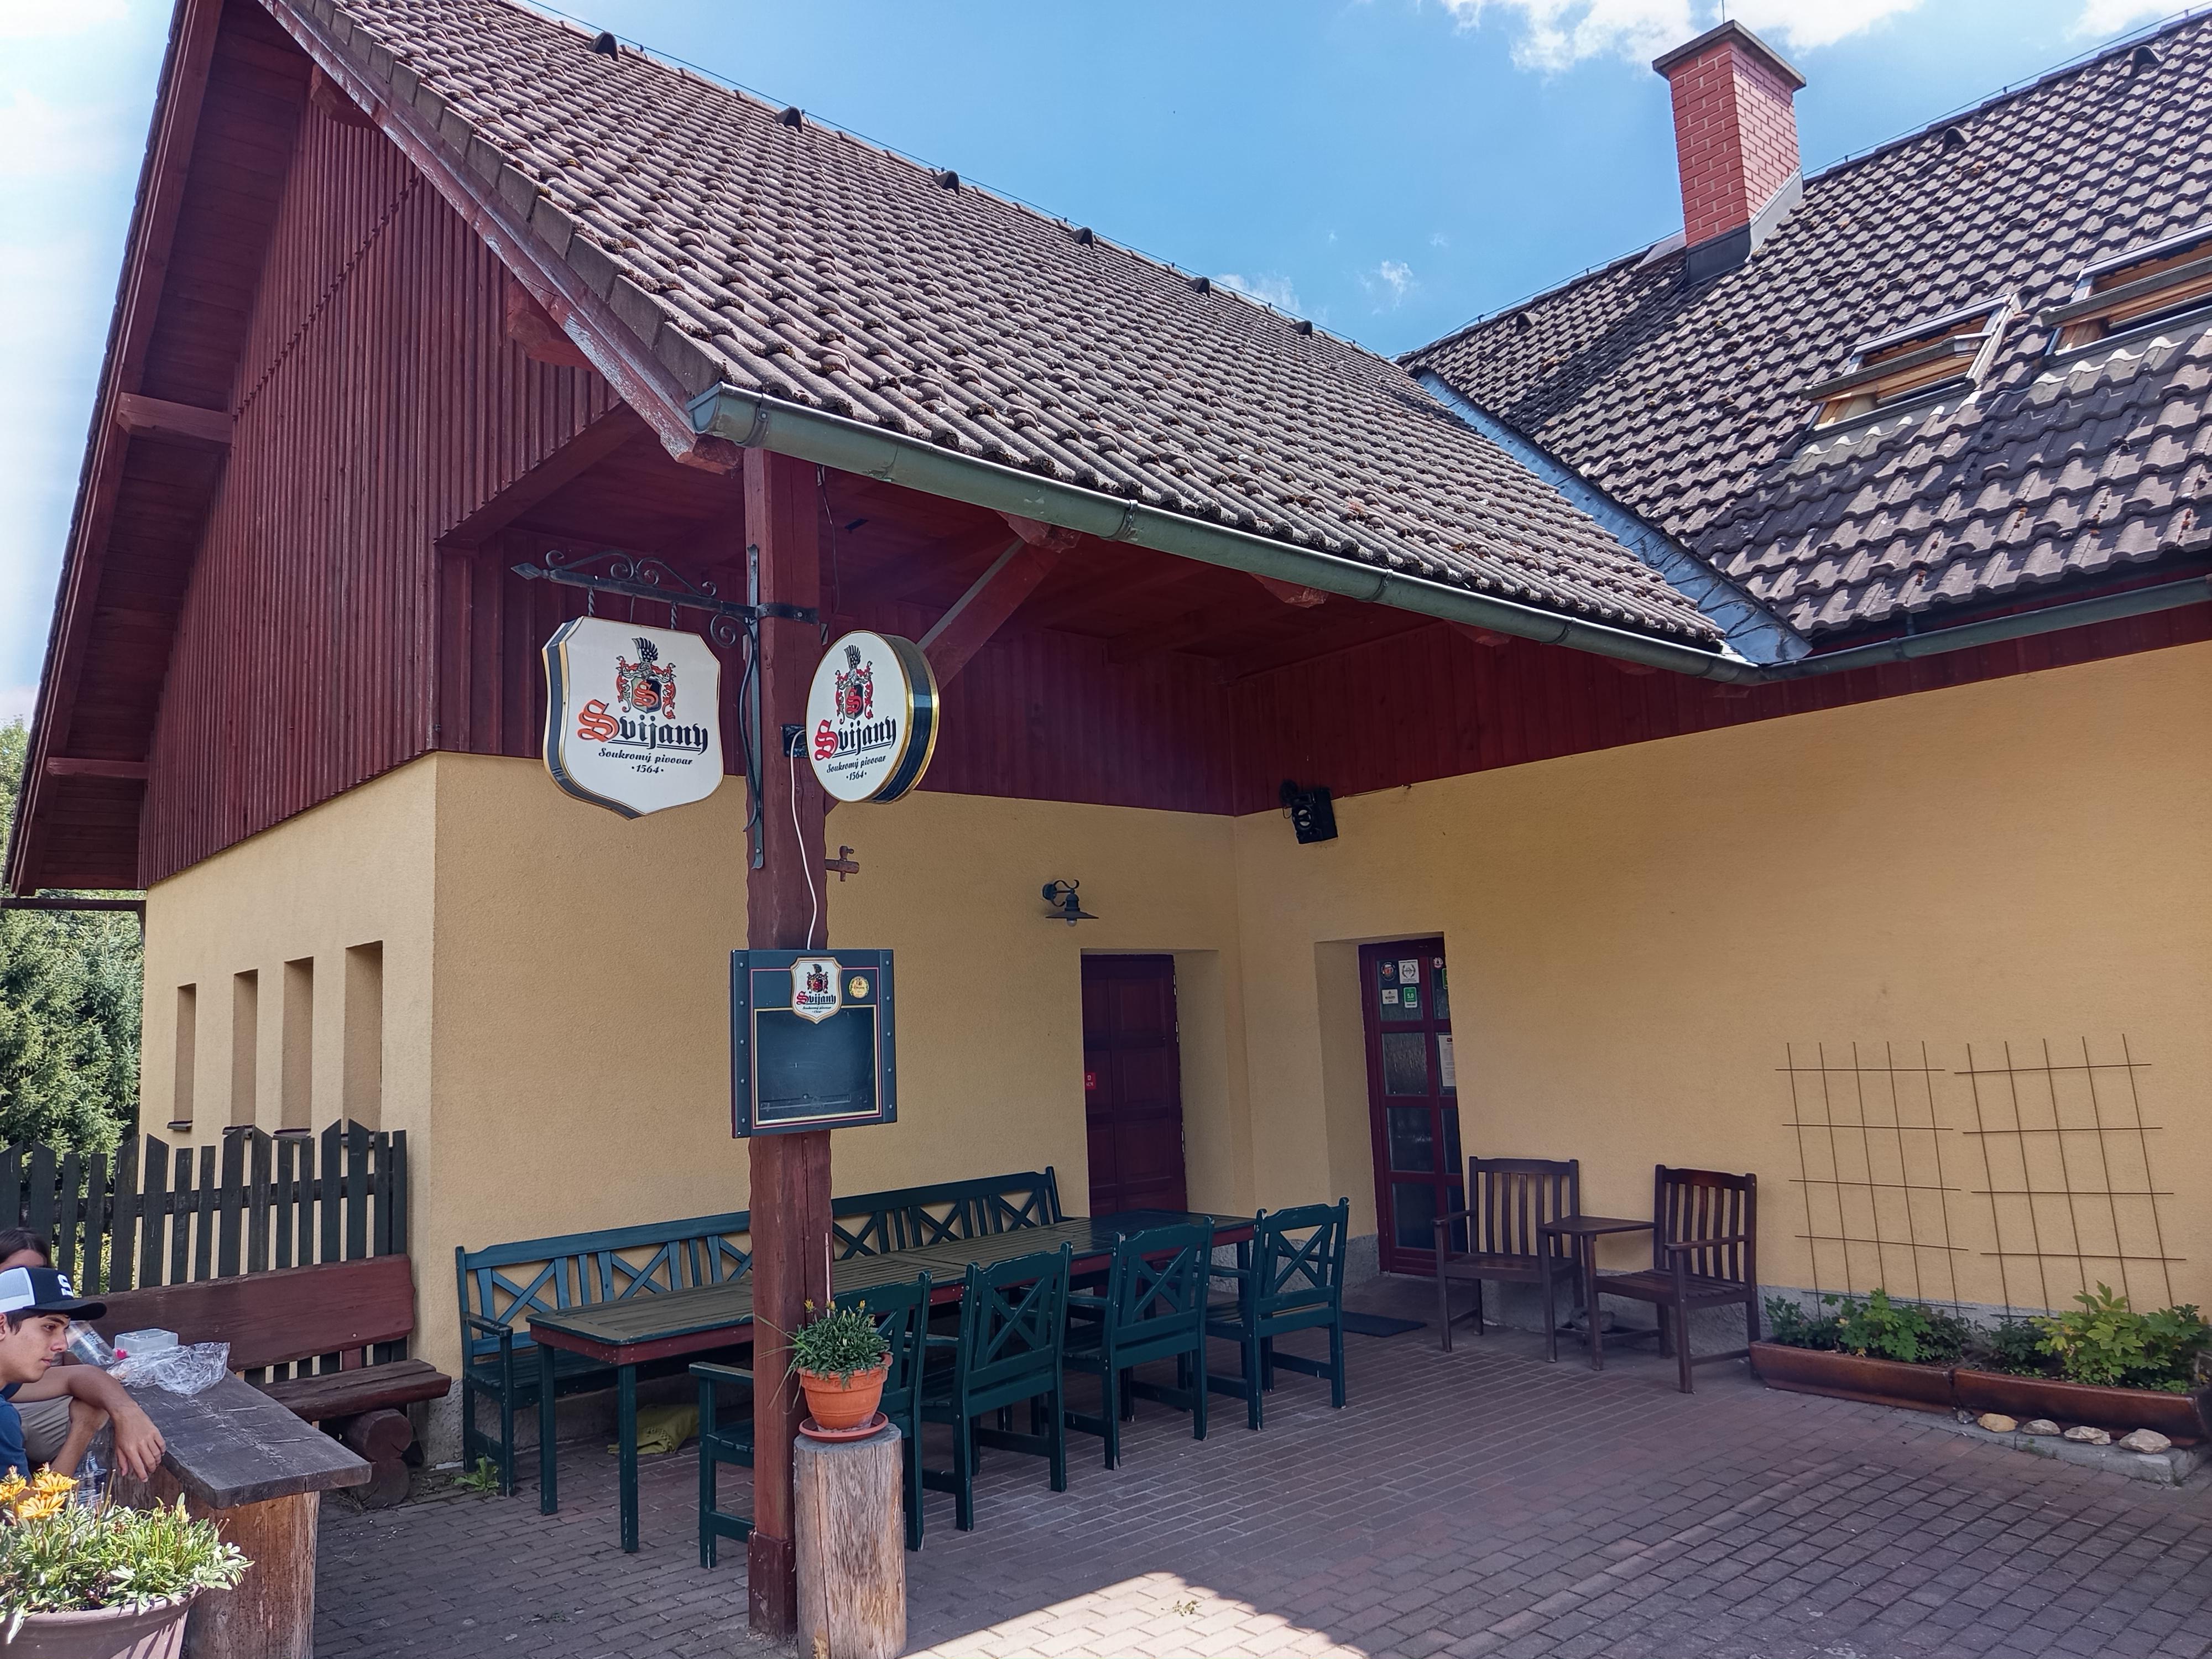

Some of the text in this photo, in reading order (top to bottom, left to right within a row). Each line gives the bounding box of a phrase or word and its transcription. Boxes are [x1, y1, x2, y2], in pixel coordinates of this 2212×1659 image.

[577, 699, 708, 755] Svijany
[815, 716, 896, 761] Svijany
[598, 748, 693, 765] Soukromý pivovar
[826, 755, 886, 773] Soukromý pivovar
[796, 991, 836, 1005] Svijany
